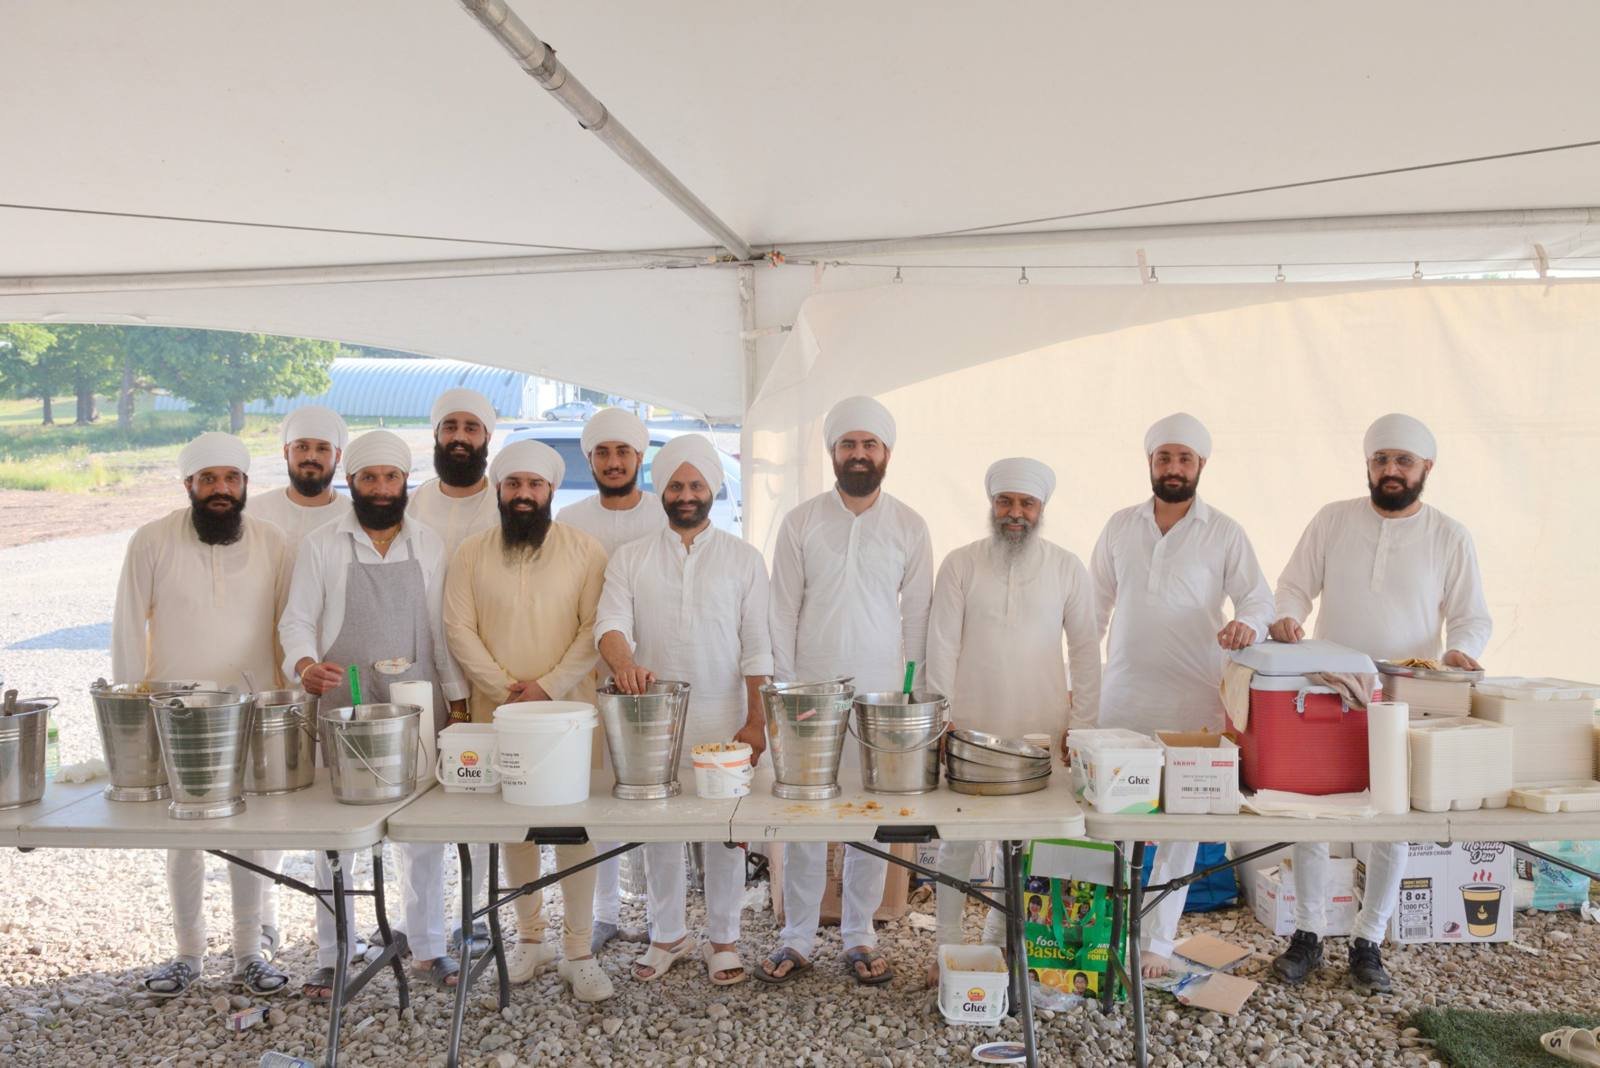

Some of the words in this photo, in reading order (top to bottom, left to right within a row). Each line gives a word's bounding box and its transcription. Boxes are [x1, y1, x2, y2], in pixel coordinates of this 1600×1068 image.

[457, 767, 482, 778] Ghee
[1127, 775, 1150, 785] Ghee
[919, 852, 937, 865] Tea
[1470, 850, 1496, 864] Dew
[1406, 892, 1412, 901] 8
[1415, 893, 1426, 901] oz
[1026, 940, 1075, 960] Basics
[962, 1002, 987, 1013] Ghee
